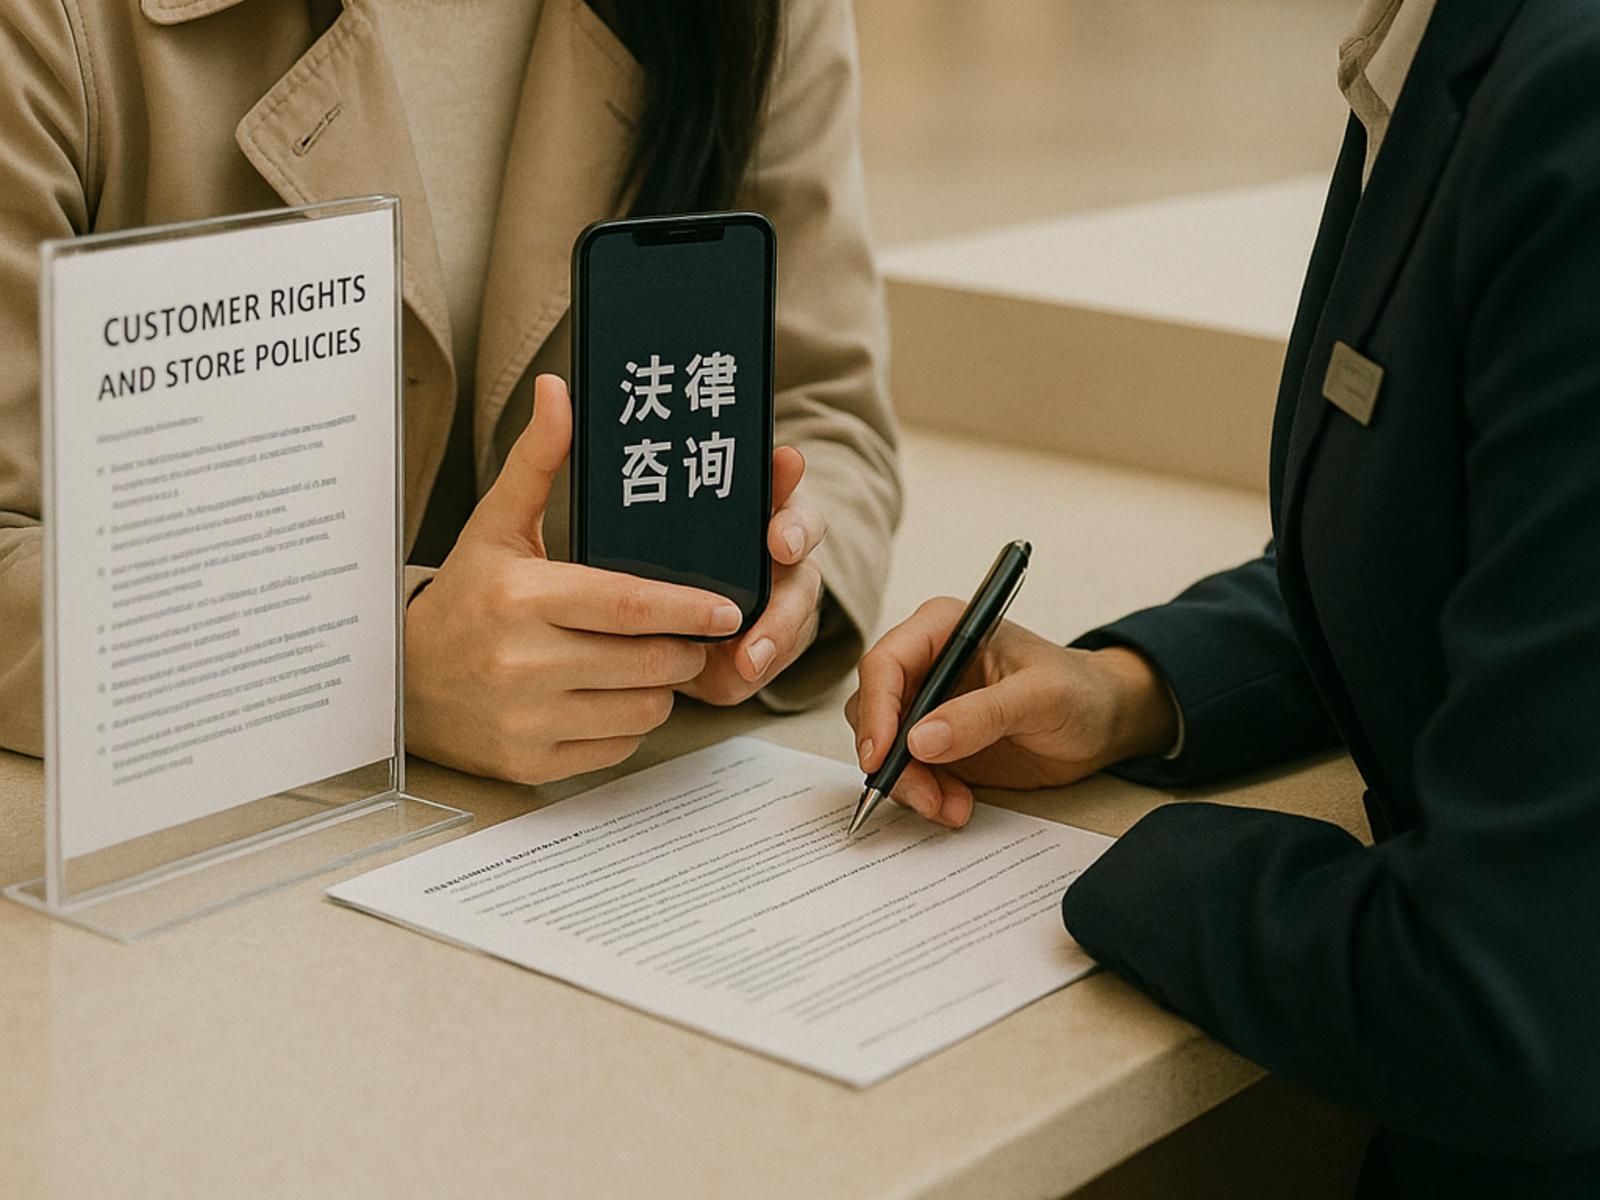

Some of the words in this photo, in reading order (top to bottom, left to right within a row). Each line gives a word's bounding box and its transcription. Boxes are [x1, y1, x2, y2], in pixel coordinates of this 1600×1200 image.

[103, 294, 260, 346] CUSTOMER
[270, 274, 366, 318] RIGHTS
[98, 366, 156, 401] AND
[166, 349, 246, 388] STORE
[255, 327, 361, 371] POLICIES
